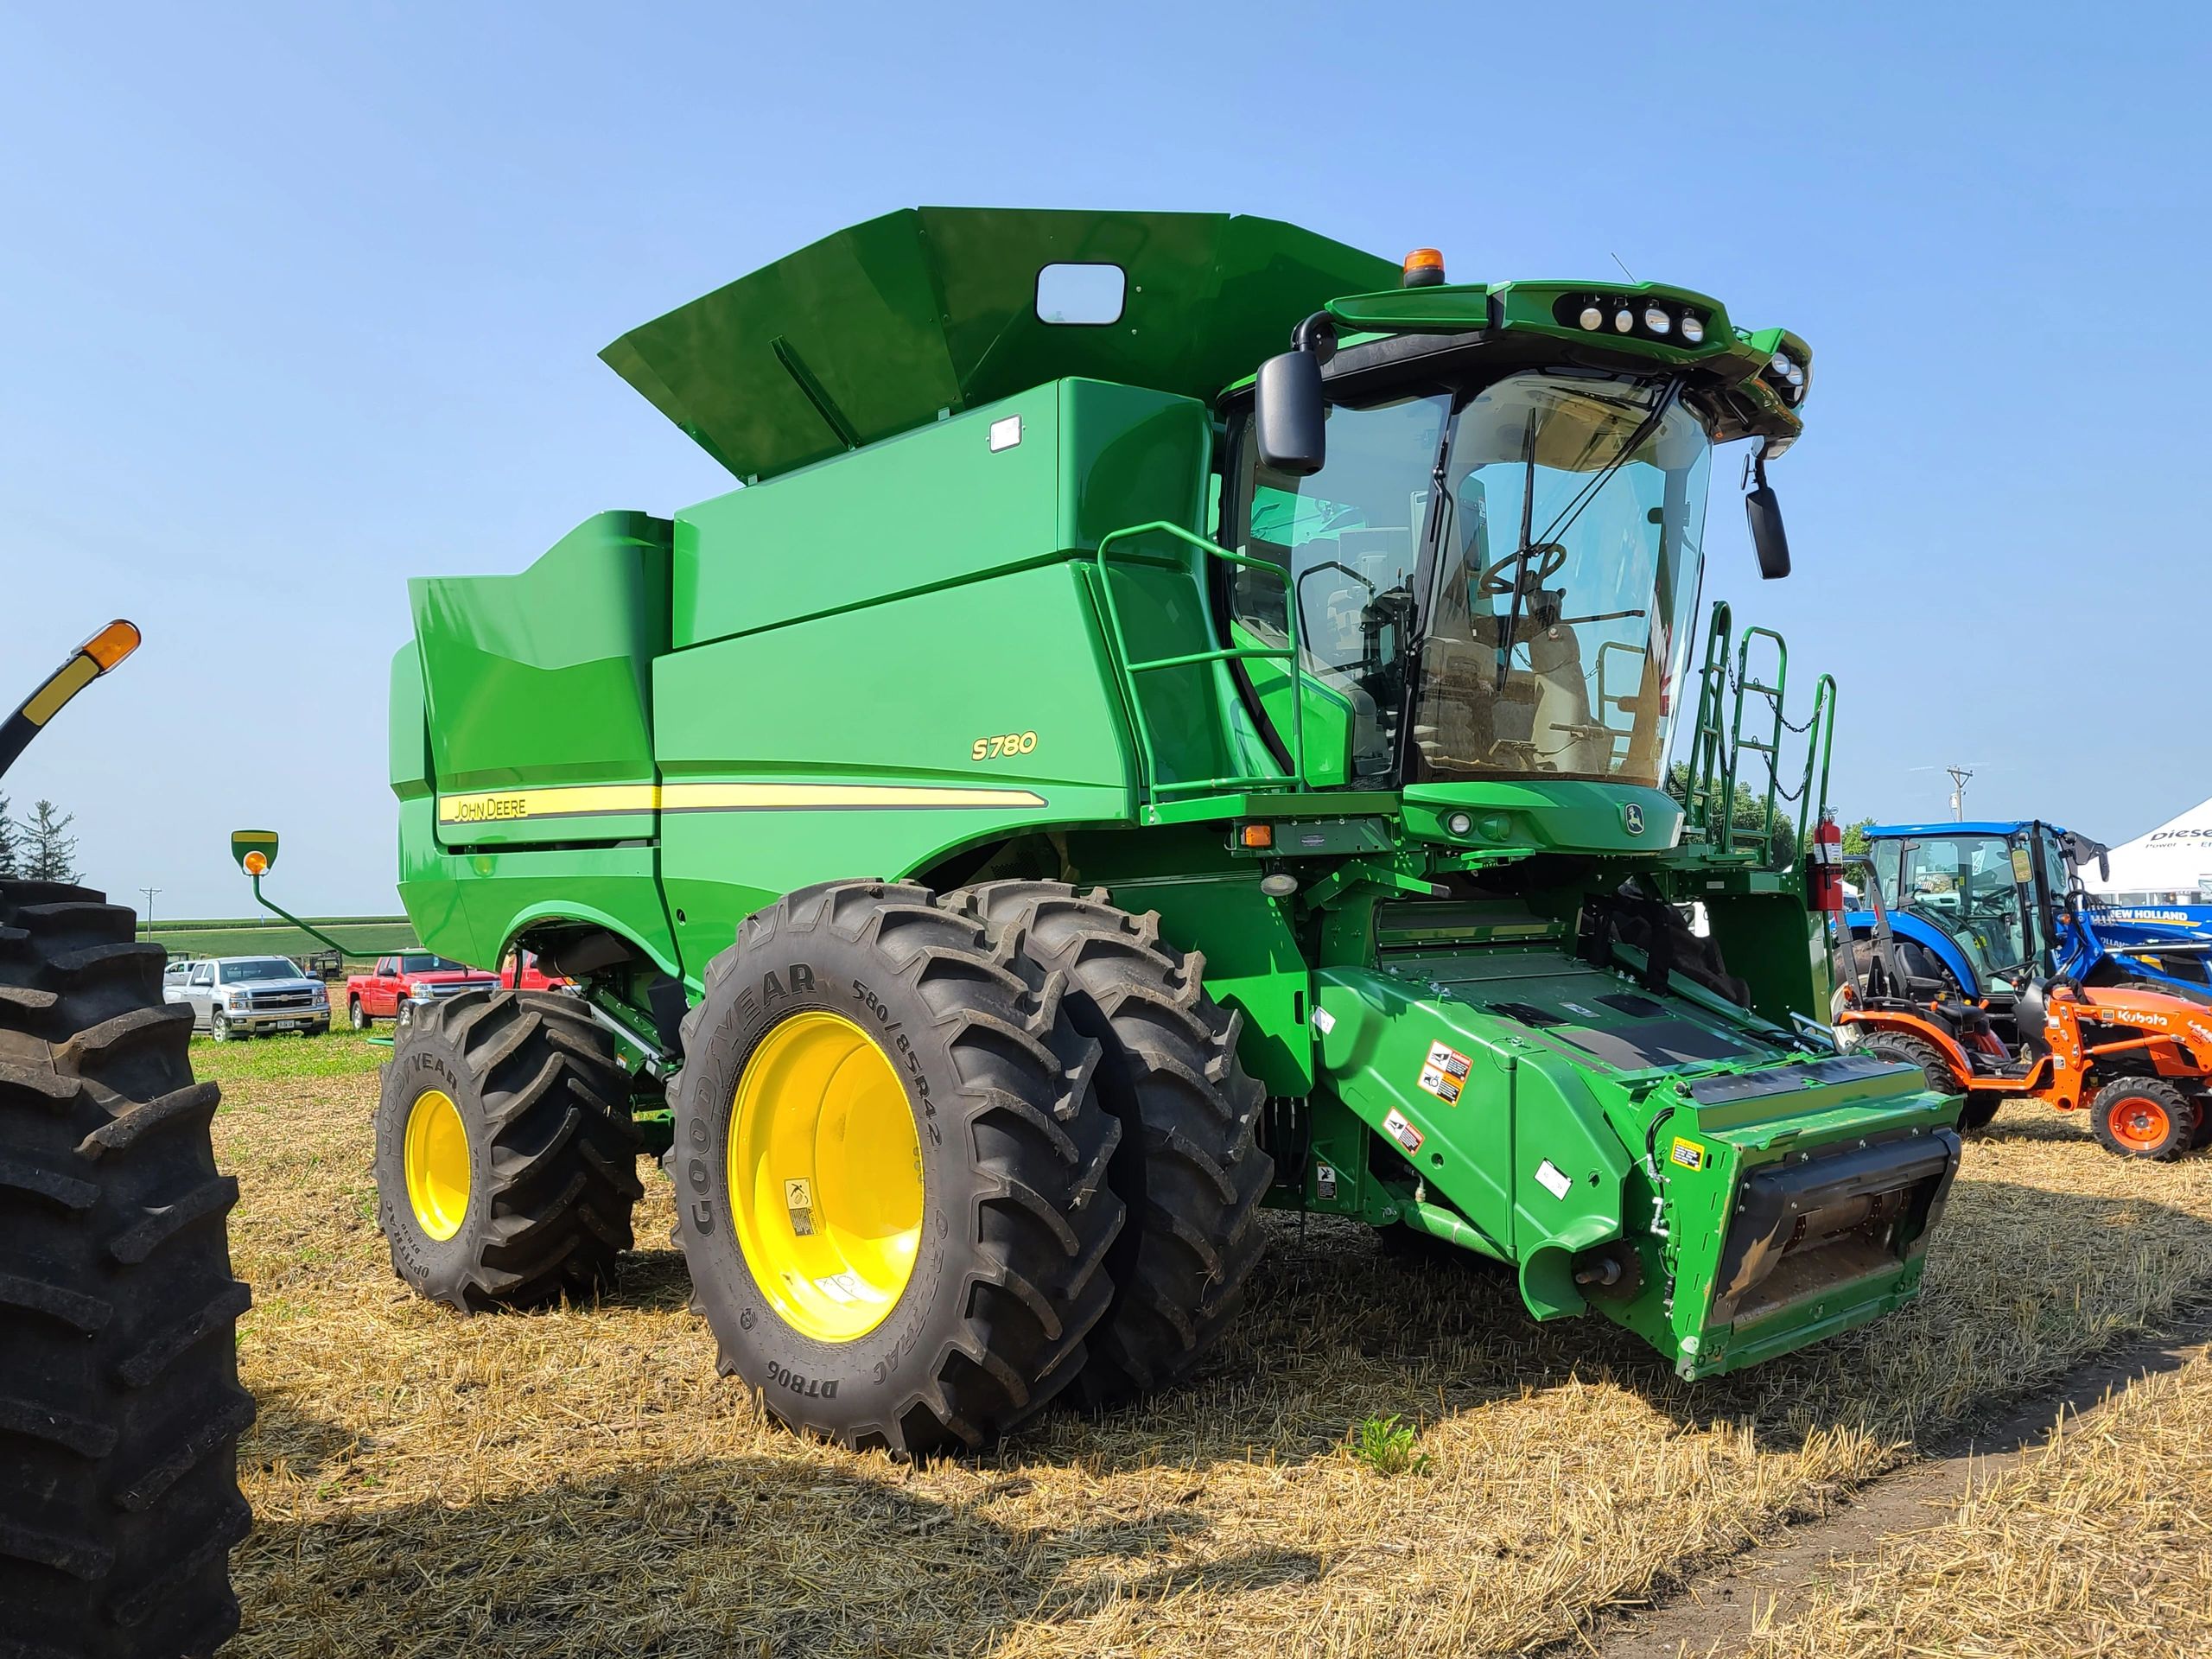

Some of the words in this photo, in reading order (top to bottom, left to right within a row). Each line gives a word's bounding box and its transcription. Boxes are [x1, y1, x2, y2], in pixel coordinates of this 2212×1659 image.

[971, 730, 1038, 761] S780
[454, 801, 485, 819] JOHN
[487, 798, 526, 817] DEERE
[2110, 909, 2133, 919] NEW
[2134, 910, 2188, 921] HOLLAND
[2117, 1010, 2168, 1026] Kubota
[852, 979, 942, 1147] 580/85R42
[689, 963, 816, 1237] GOODYEAR
[386, 1199, 429, 1278] OPTITRAC
[766, 1360, 839, 1399] DT806
